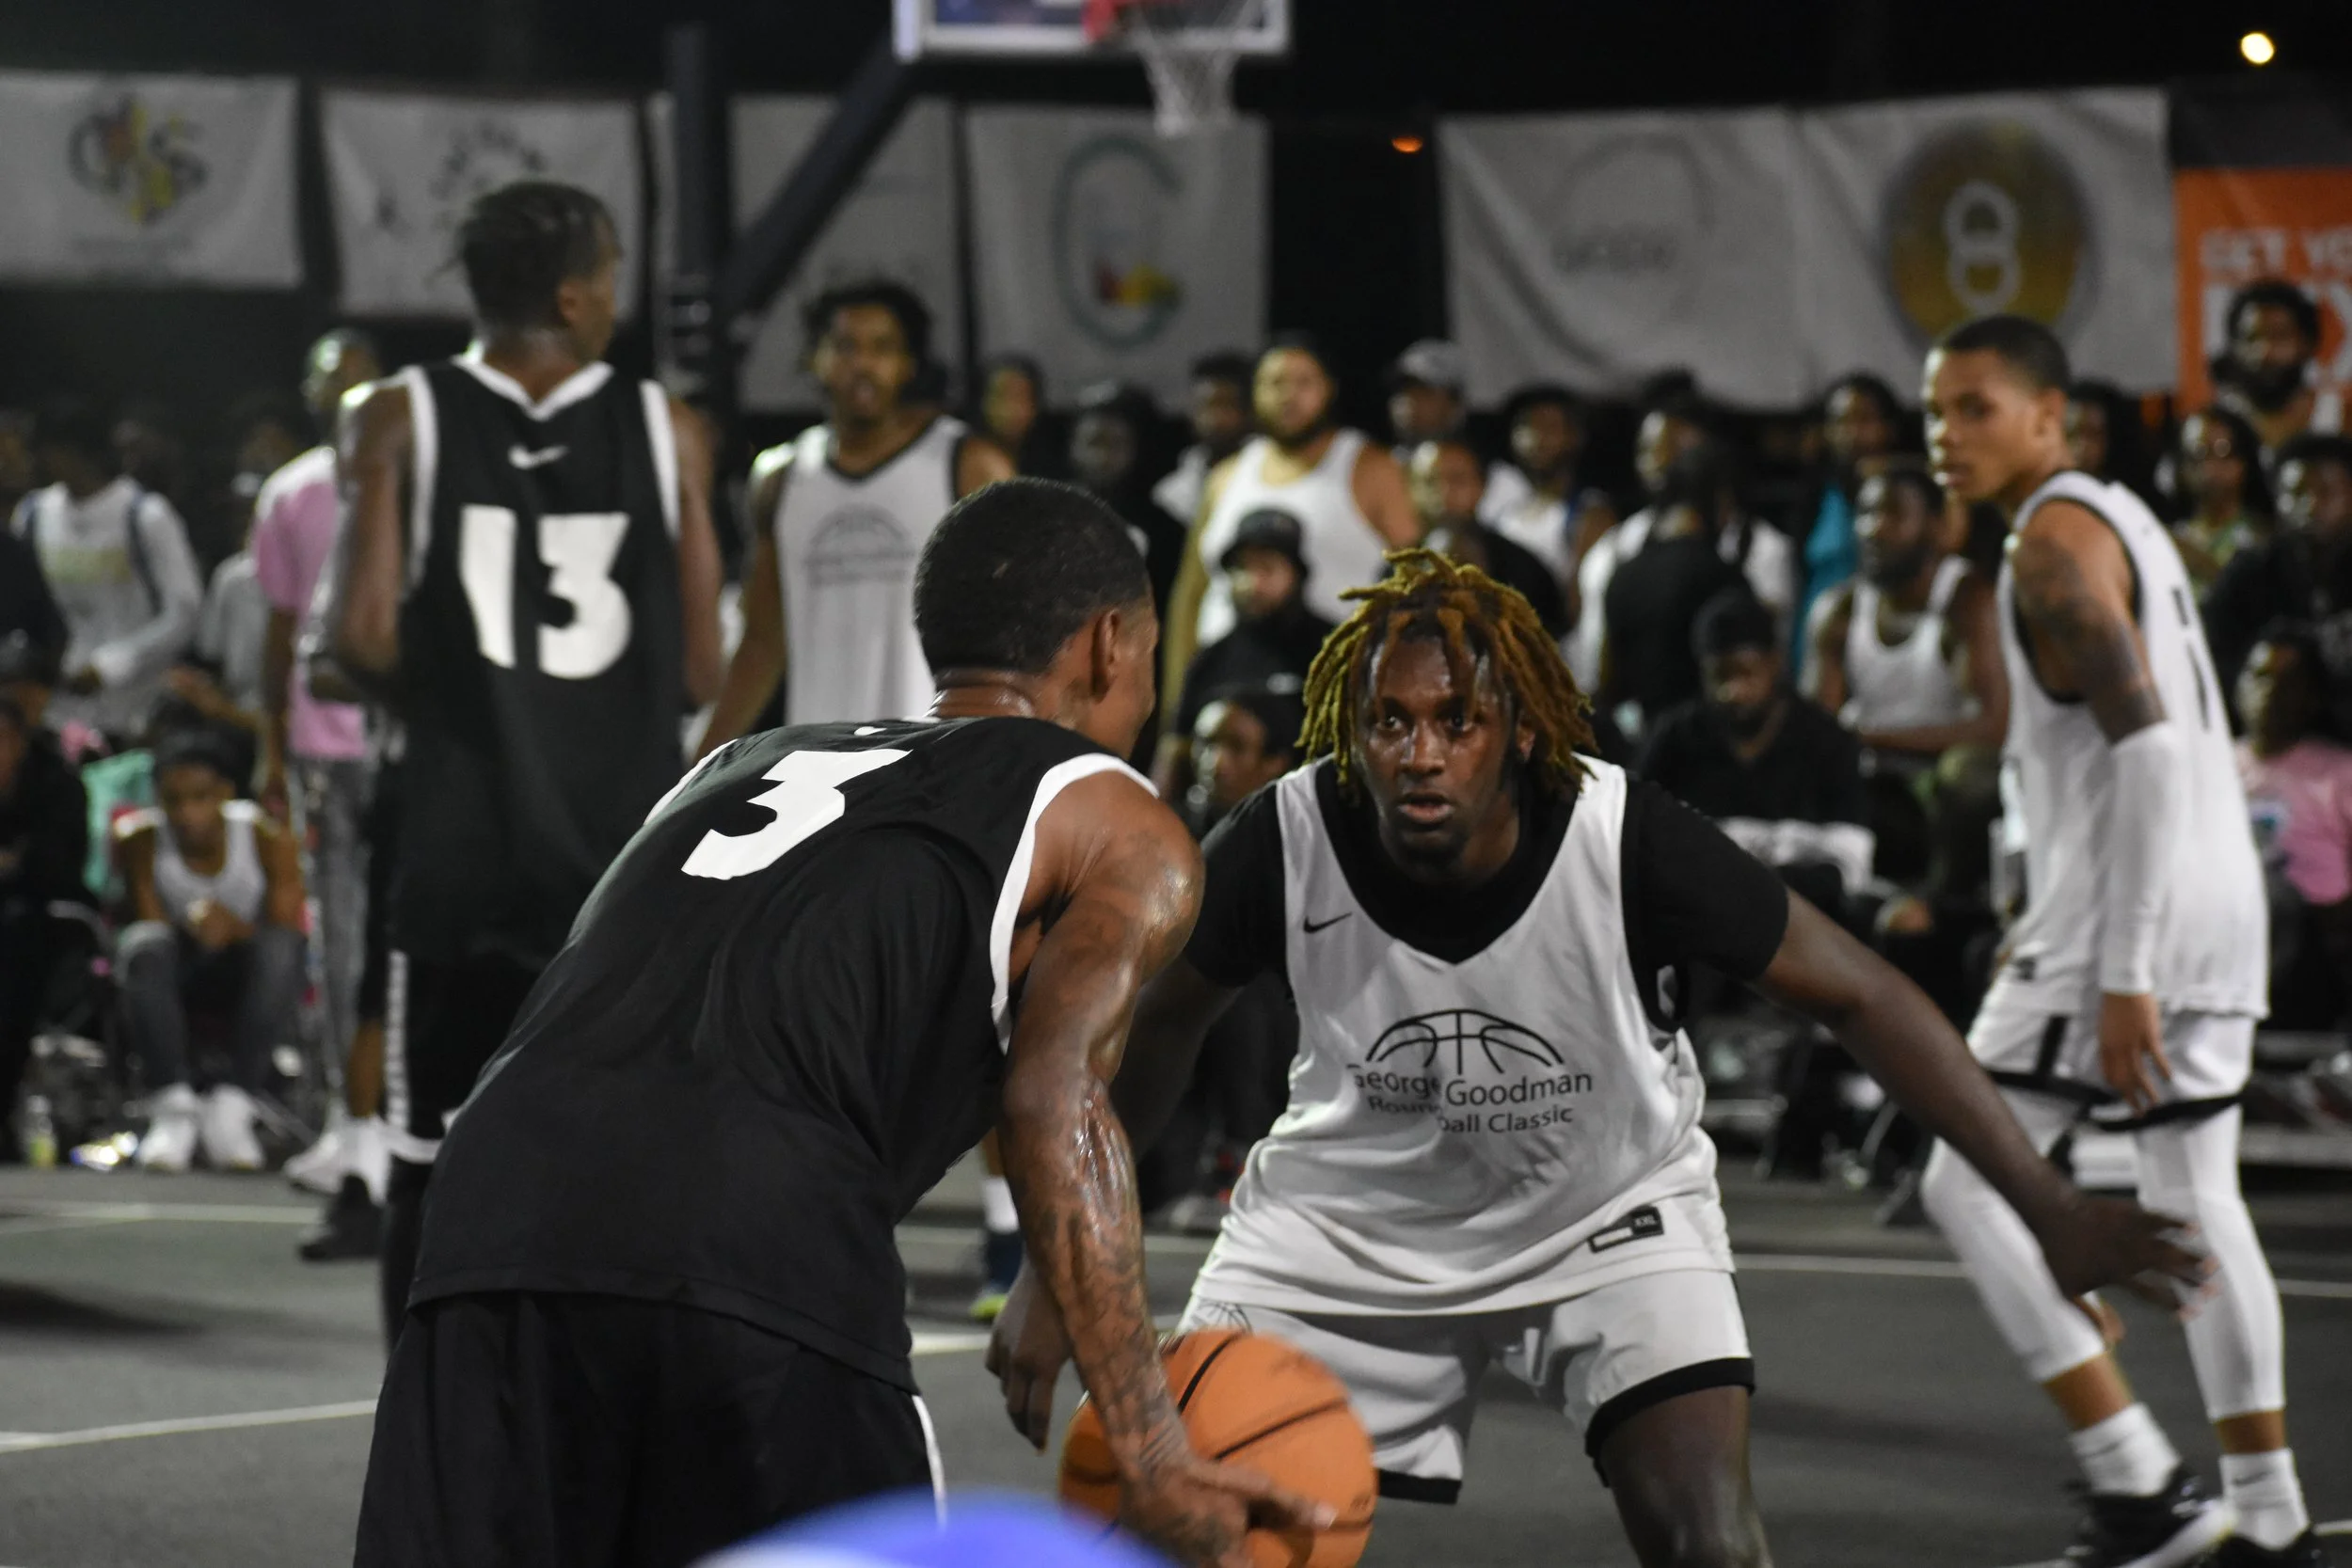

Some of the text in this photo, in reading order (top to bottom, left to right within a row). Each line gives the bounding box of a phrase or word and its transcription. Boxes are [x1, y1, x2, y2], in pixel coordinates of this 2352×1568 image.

[458, 502, 632, 679] 13
[681, 749, 914, 880] 3
[1445, 1072, 1593, 1106] Goodman
[1487, 1103, 1574, 1133] Classic
